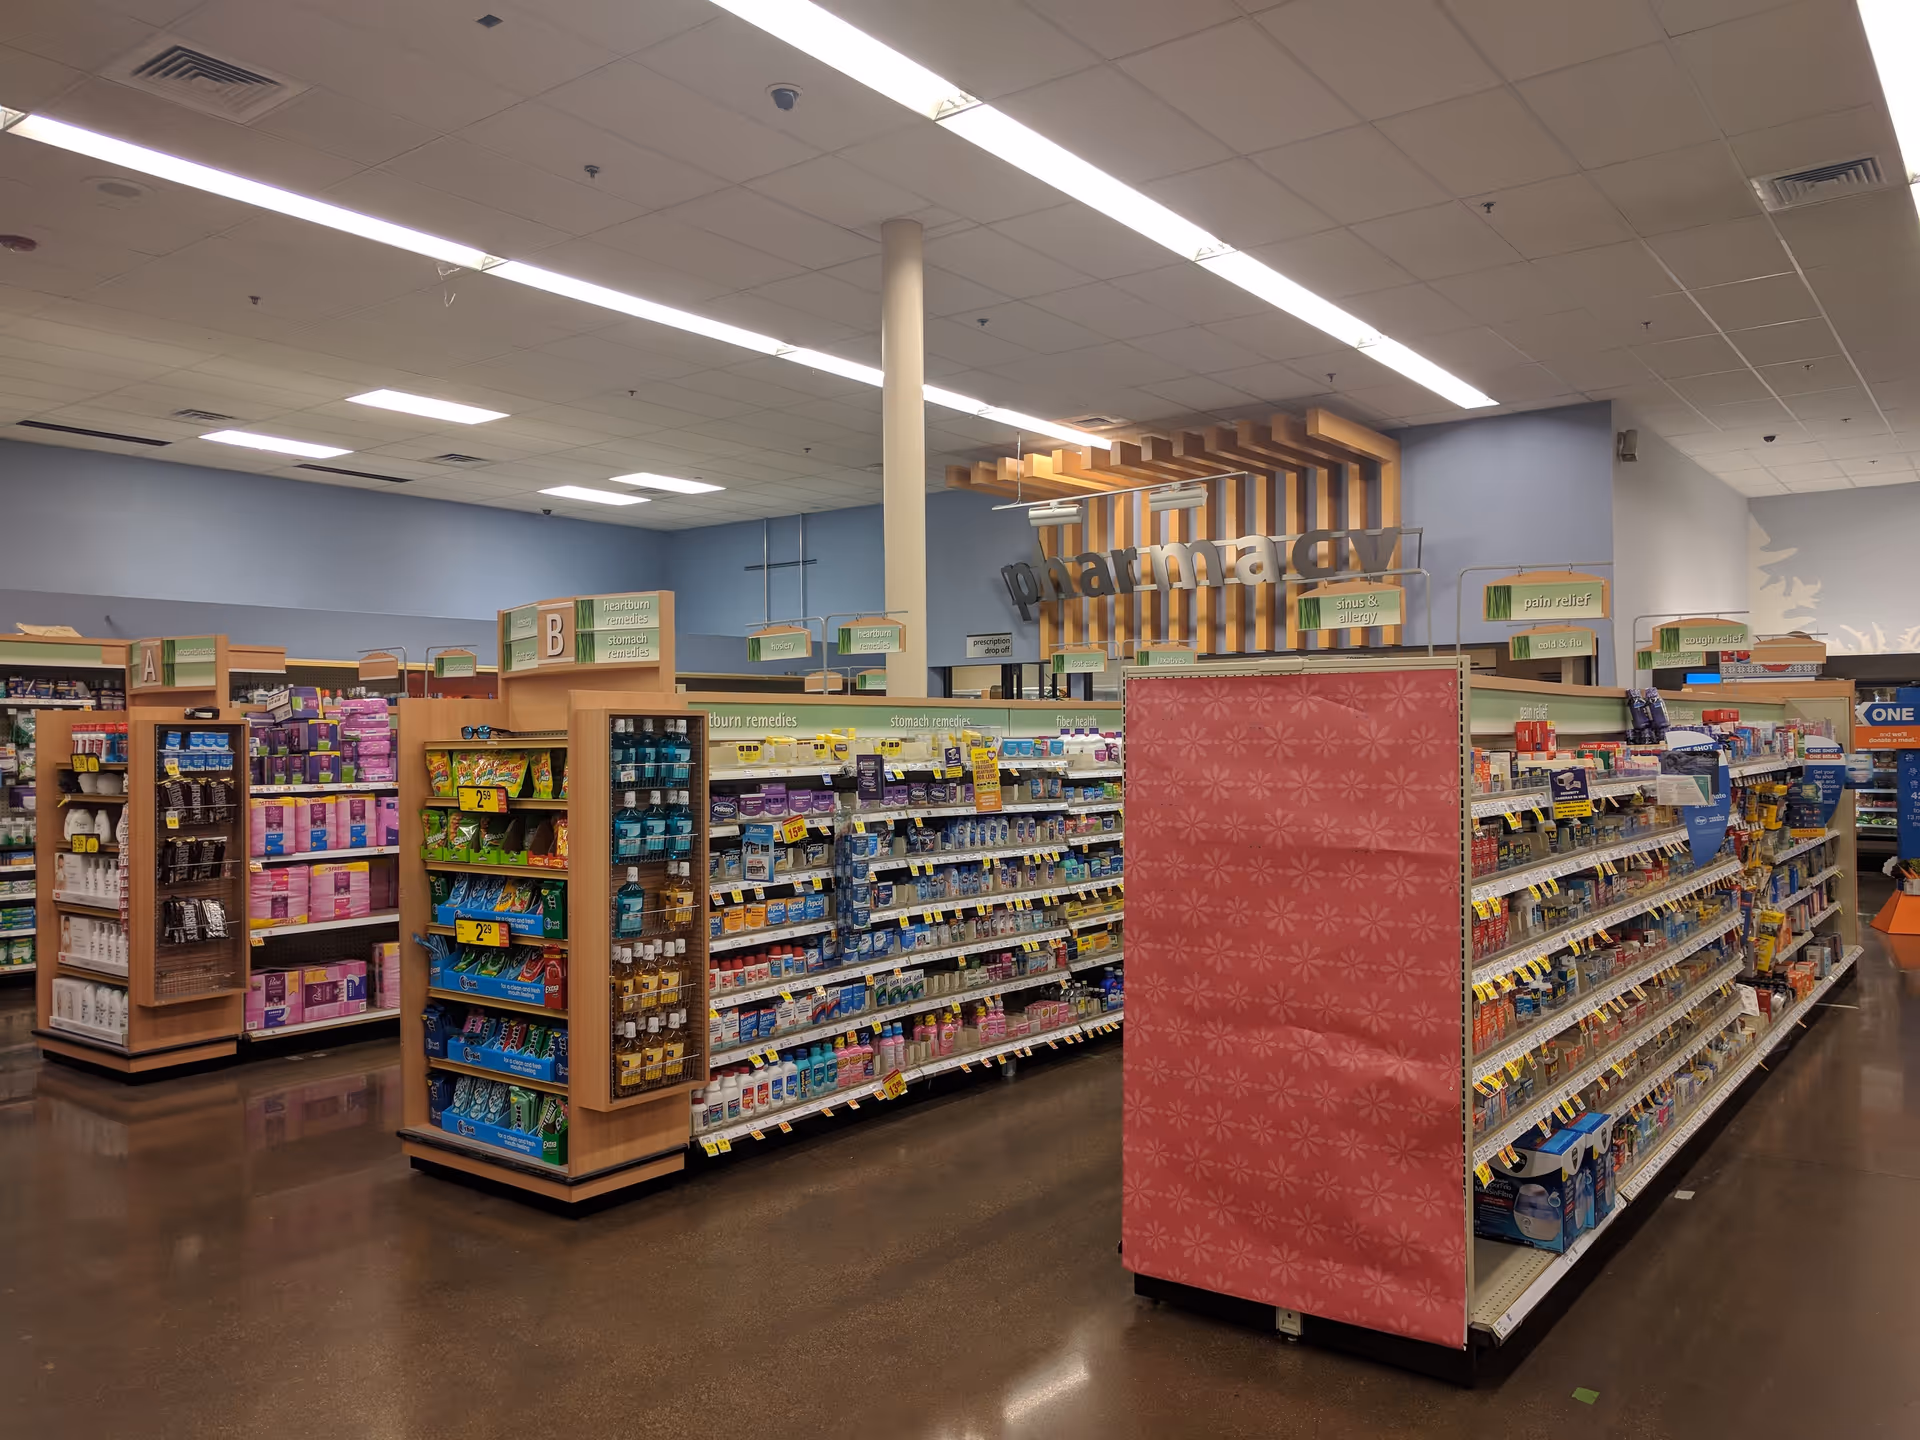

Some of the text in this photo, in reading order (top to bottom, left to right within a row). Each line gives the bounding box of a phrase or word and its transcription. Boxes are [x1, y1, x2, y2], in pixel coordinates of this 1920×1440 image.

[1001, 527, 1402, 624] pharmacy
[603, 600, 650, 613] heartburn
[1336, 594, 1379, 610] sinus &
[1524, 592, 1592, 611] pain relief
[606, 613, 648, 626] remedies
[1338, 610, 1377, 625] allergy
[546, 613, 564, 657] B
[607, 633, 648, 646] stomach
[858, 628, 892, 640] heartburn
[1684, 633, 1744, 647] cough relief
[771, 640, 796, 652] hosiery
[859, 640, 890, 651] remedies
[973, 636, 1011, 647] prescription
[1538, 637, 1582, 650] cold & flu
[607, 646, 649, 659] remedies
[985, 646, 1010, 656] drop off
[144, 648, 157, 682] A
[1520, 704, 1548, 721] pain relief
[1872, 708, 1915, 722] ONE
[708, 712, 798, 728] tburn remedies
[891, 715, 971, 729] stomach remedies
[1056, 715, 1097, 727] fiber health
[768, 902, 785, 912] Pepcid
[709, 916, 720, 926] pcid
[459, 975, 478, 991] Orbit
[463, 1047, 481, 1063] Orbit
[457, 1119, 476, 1136] Orbit
